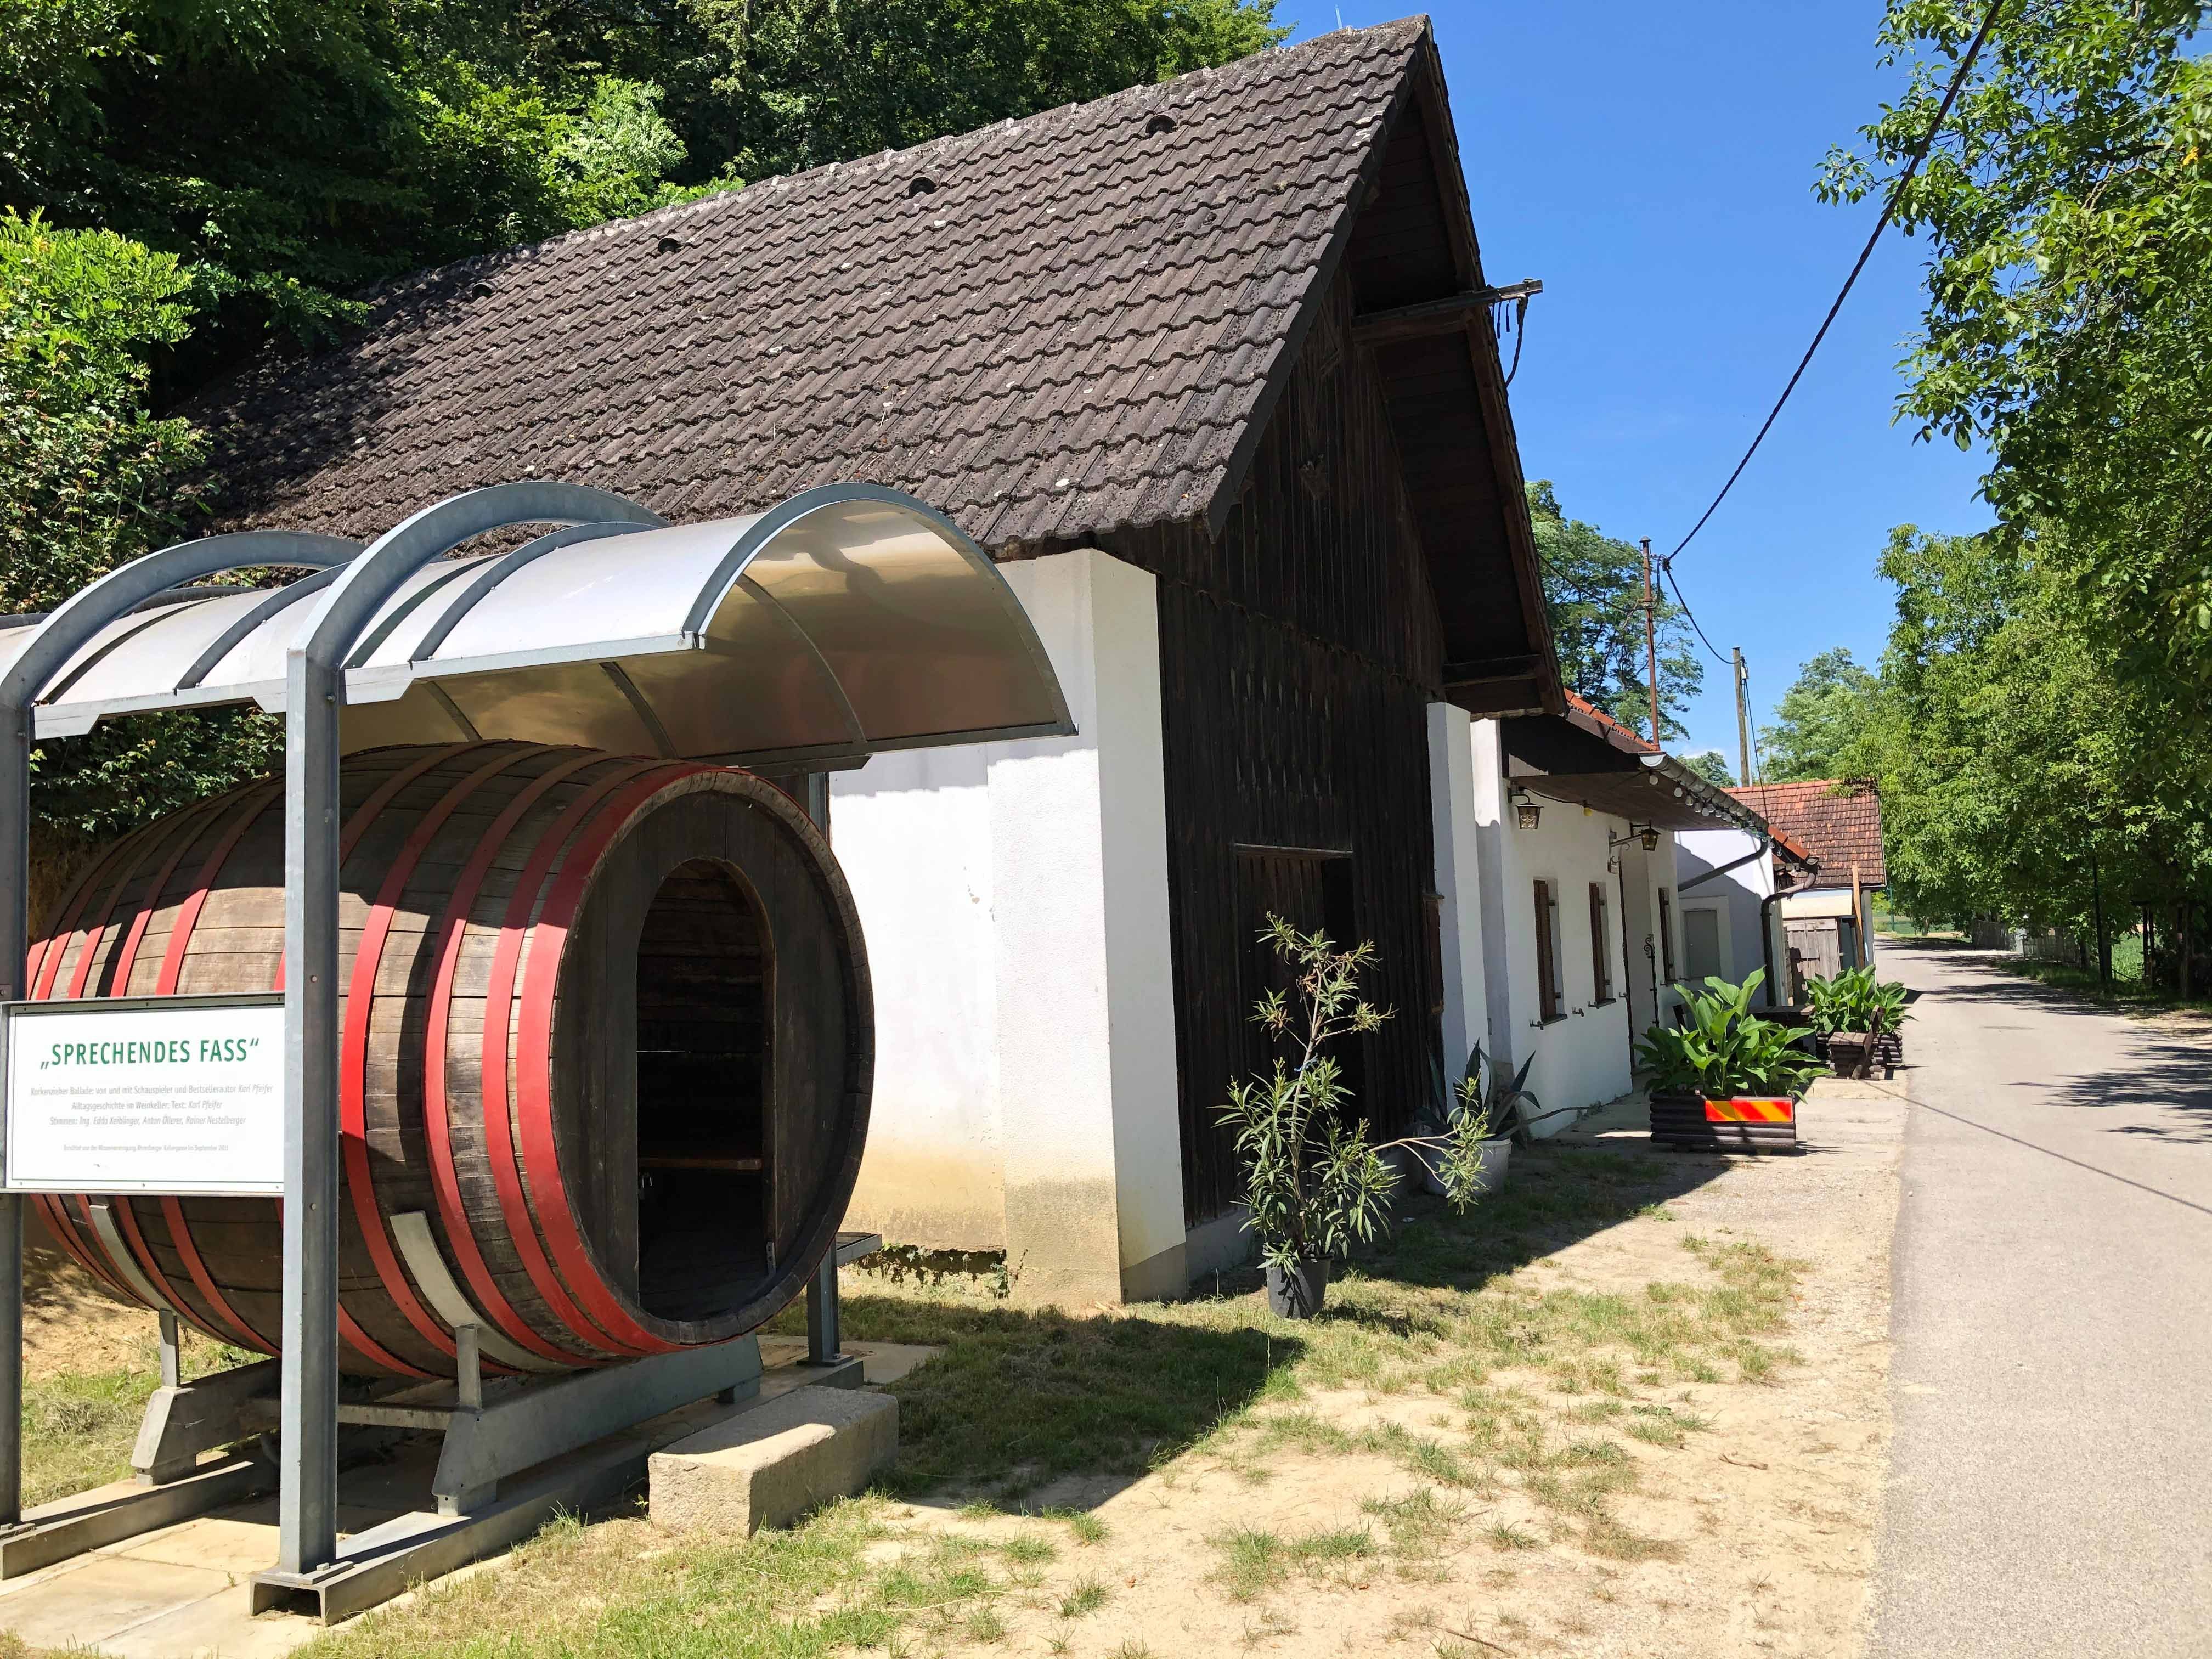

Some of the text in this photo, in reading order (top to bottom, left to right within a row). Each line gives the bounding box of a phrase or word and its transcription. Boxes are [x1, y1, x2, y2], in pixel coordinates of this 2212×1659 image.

[109, 1086, 120, 1094] und
[122, 1086, 133, 1094] mit
[134, 1085, 172, 1096] Schauspieler
[189, 1084, 236, 1093] Bestsellerautor
[238, 1084, 251, 1093] Karl
[252, 1084, 272, 1094] Pfeifer
[71, 1102, 125, 1111] Alltagsgeschichte
[202, 1100, 222, 1110] Pfeifer
[49, 1116, 77, 1125] Stimmen:
[80, 1116, 91, 1127] Ing.
[185, 1116, 206, 1124] Rainer
